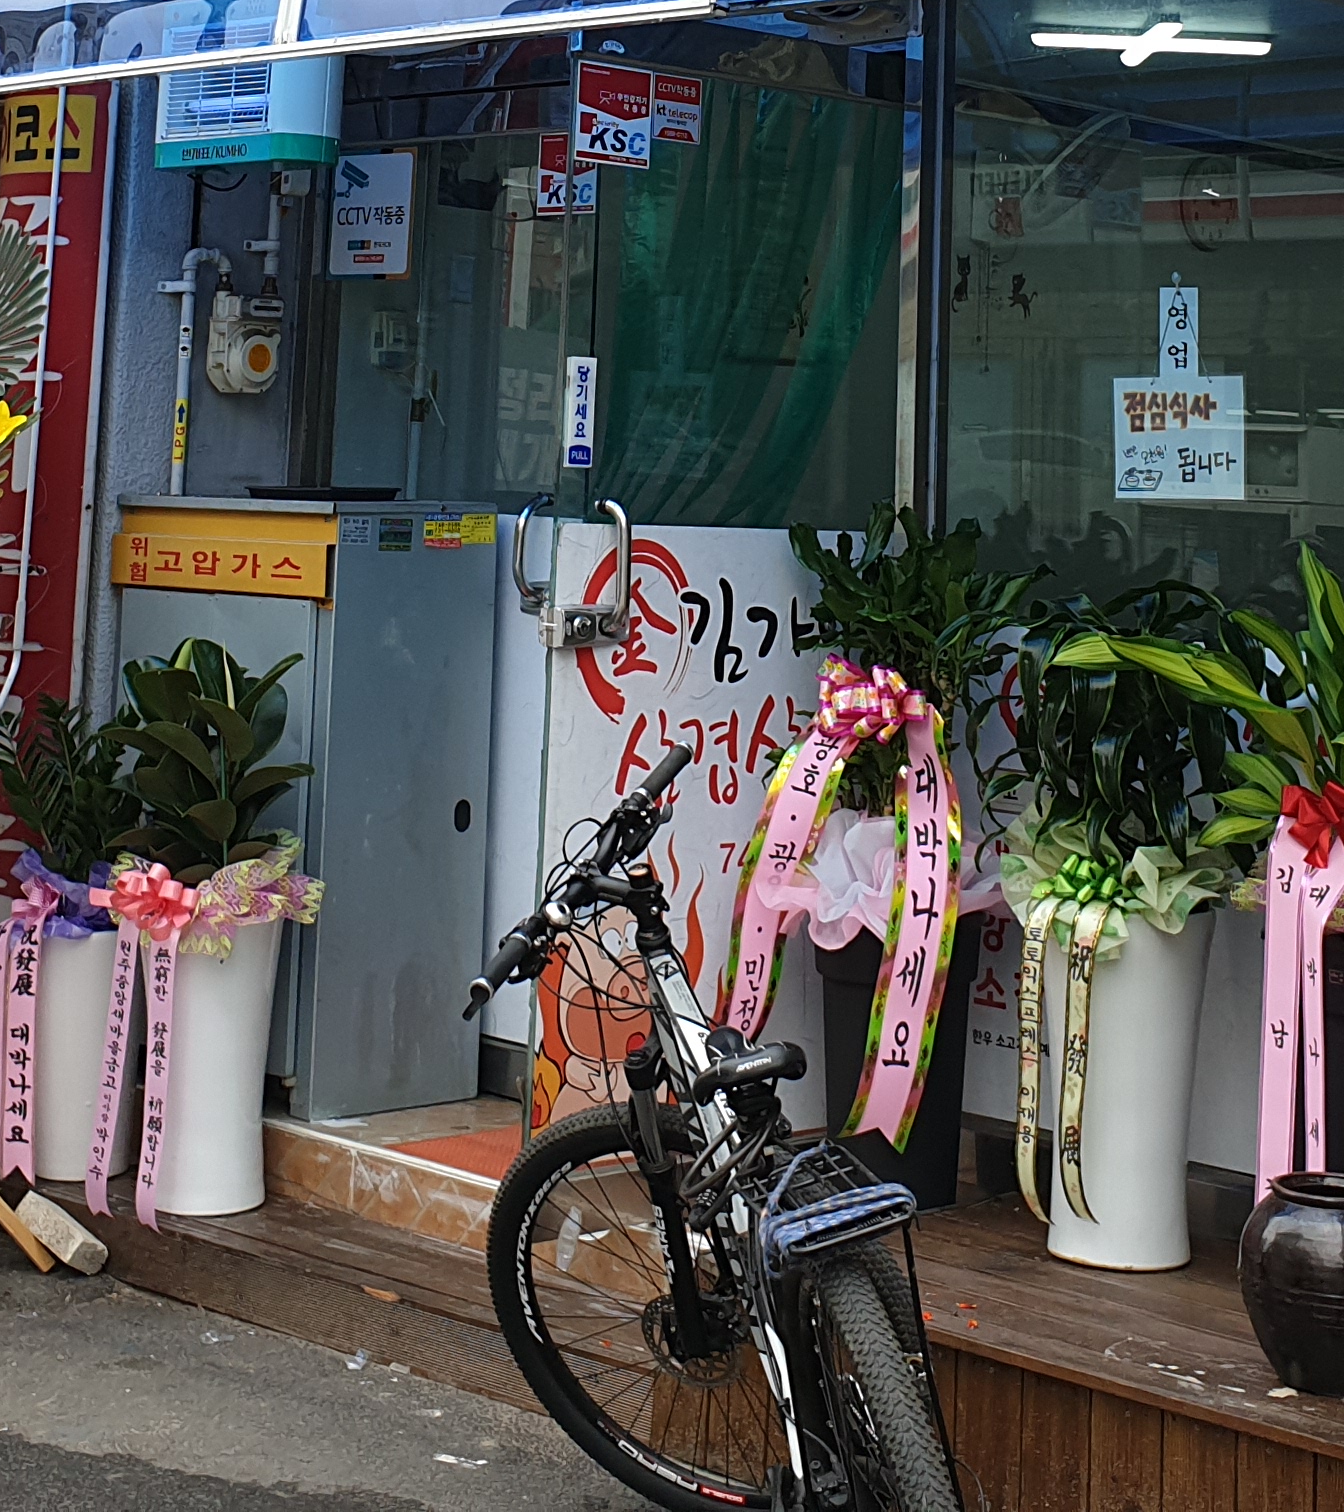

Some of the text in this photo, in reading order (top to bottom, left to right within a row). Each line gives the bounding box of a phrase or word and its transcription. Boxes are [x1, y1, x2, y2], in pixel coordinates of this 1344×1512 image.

[588, 127, 646, 156] KSC
[1168, 303, 1187, 369] 영업
[574, 365, 591, 439] 당기세요
[1123, 391, 1217, 432] 점심식사
[174, 425, 186, 461] LPG
[571, 450, 588, 462] PULL
[1177, 447, 1236, 483] 됩니다
[130, 537, 303, 583] 위험 고압가스
[679, 577, 816, 683] 김가
[881, 752, 942, 1068] 대박나세요
[735, 952, 766, 1032] 민정
[5, 1022, 32, 1144] 대박나세요
